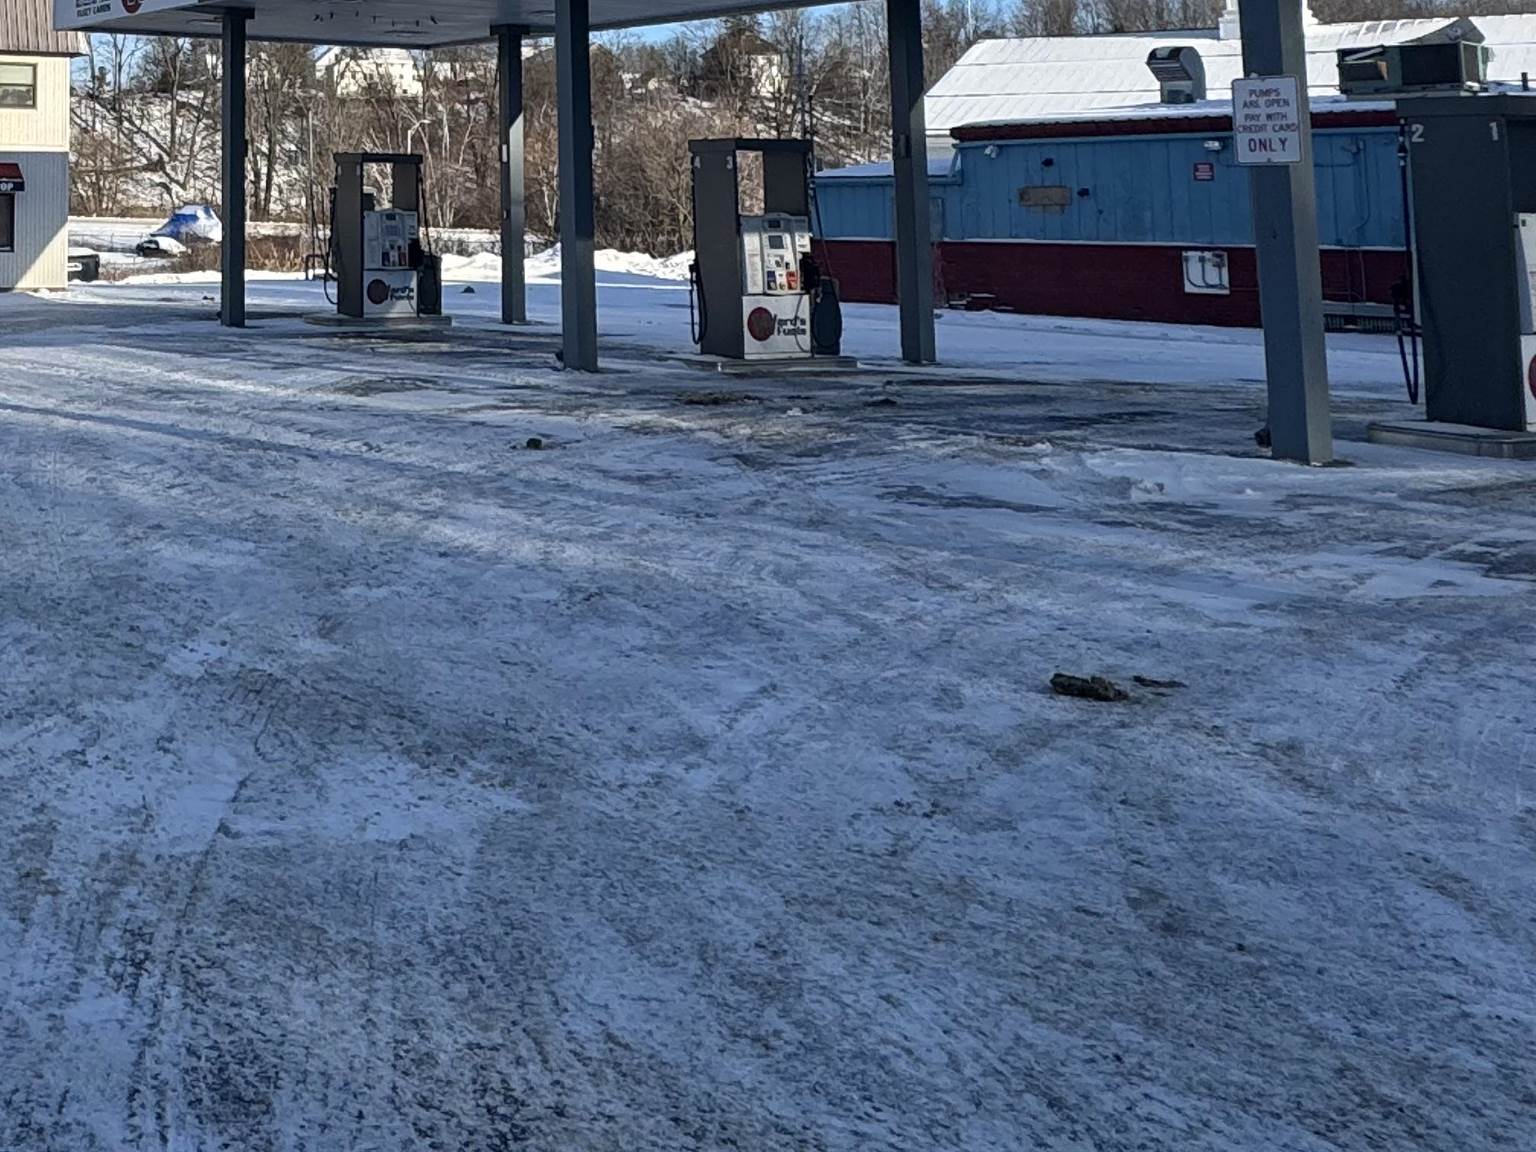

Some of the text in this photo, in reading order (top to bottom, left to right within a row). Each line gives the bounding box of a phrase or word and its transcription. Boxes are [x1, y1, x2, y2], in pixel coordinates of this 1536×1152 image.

[1248, 88, 1281, 98] PUMPS
[1243, 98, 1290, 108] ARE OPEN
[1244, 112, 1288, 122] PAY WITH
[1237, 123, 1297, 134] CREDIT CARD
[1411, 123, 1425, 143] 2
[1489, 121, 1500, 141] 1
[1248, 137, 1288, 153] ONLY
